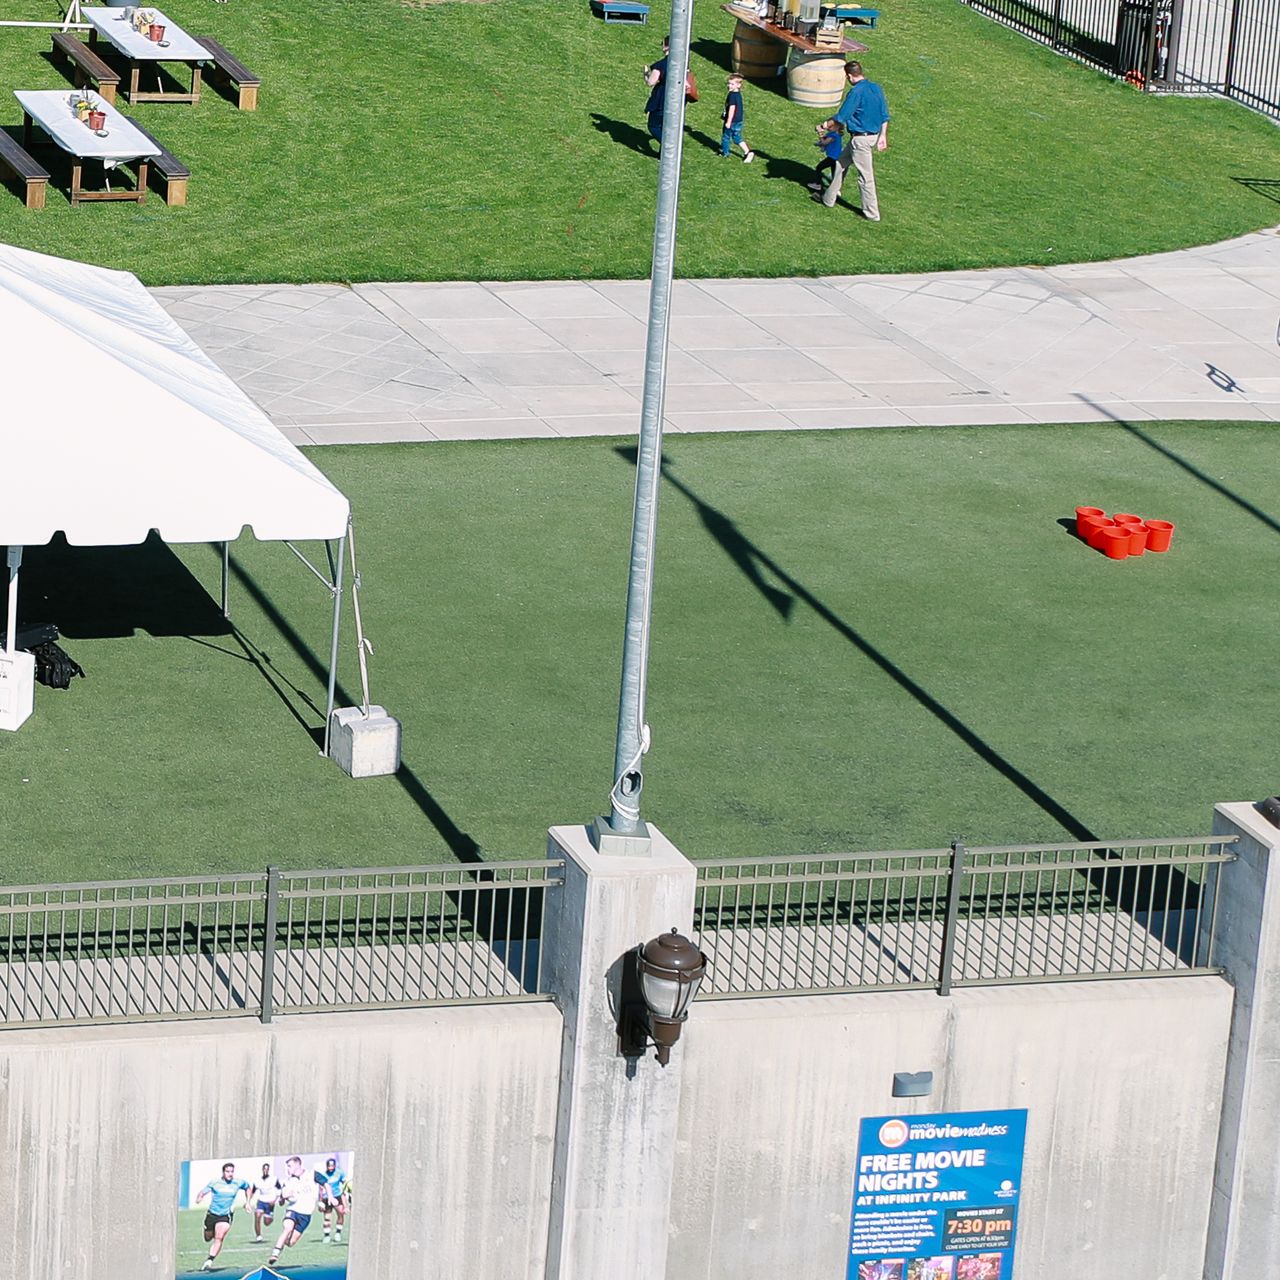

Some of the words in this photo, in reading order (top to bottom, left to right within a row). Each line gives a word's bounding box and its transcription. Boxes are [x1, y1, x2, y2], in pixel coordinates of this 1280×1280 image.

[860, 1153, 912, 1172] FREE
[915, 1149, 986, 1169] MOVIE
[858, 1171, 939, 1192] NIGHTS
[857, 1196, 874, 1206] AT
[876, 1193, 932, 1204] INFINITY
[933, 1190, 967, 1202] PARK
[948, 1219, 982, 1234] 7:30
[985, 1220, 1011, 1235] pm
